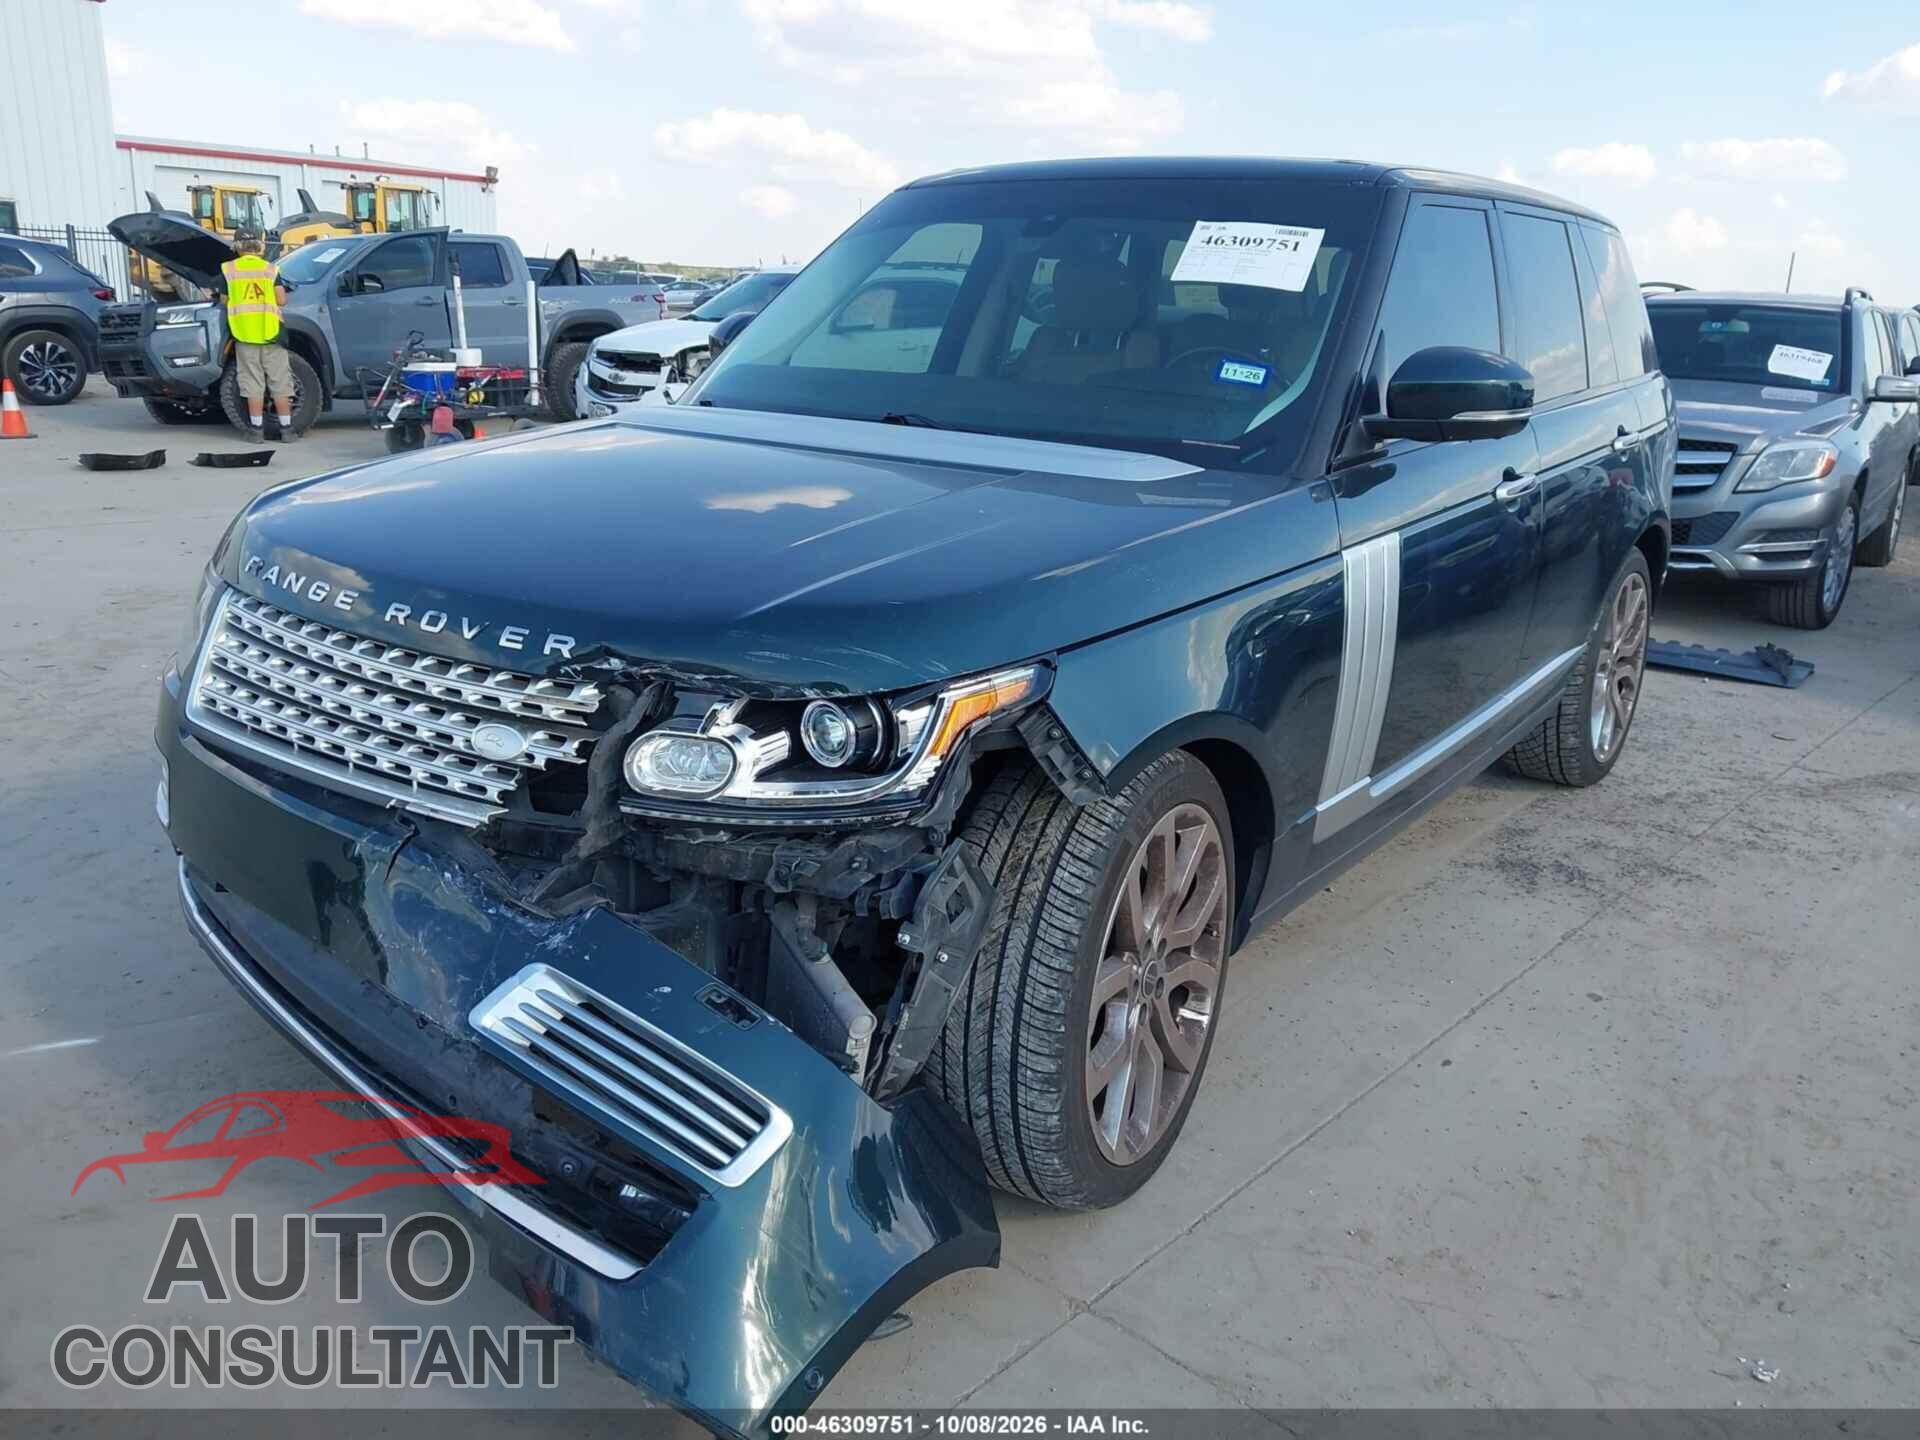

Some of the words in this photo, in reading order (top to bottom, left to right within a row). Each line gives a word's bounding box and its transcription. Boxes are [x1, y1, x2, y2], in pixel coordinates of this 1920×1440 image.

[1200, 233, 1301, 252] 46309751
[244, 555, 359, 611] RANGE
[384, 602, 577, 659] ROVER
